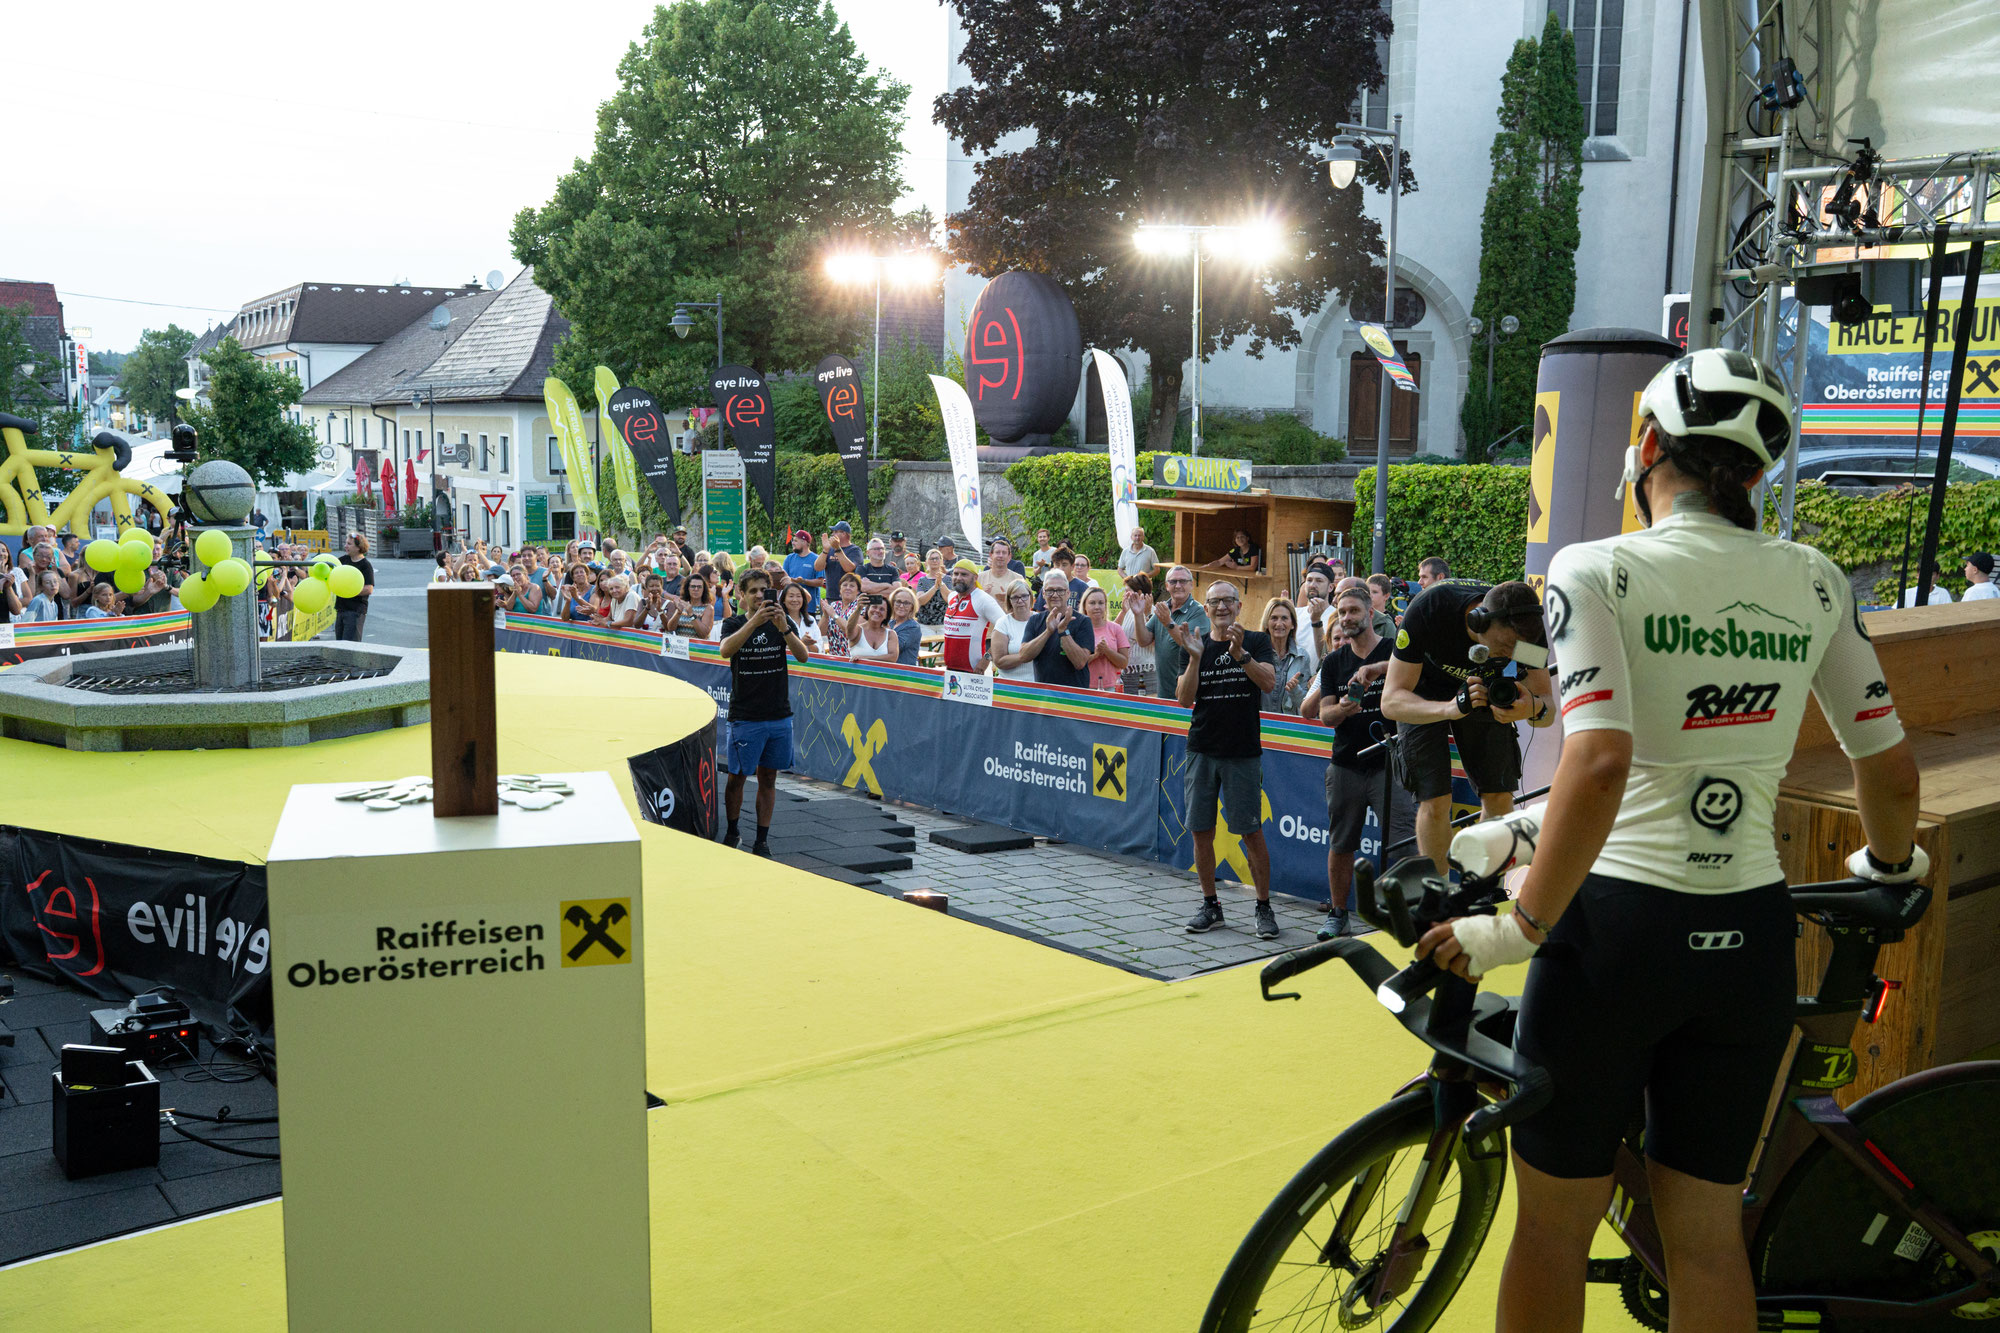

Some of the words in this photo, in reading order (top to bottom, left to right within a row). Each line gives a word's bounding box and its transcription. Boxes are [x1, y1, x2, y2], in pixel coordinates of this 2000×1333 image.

[1186, 458, 1240, 490] DRINKS
[1644, 613, 1812, 663] Wiesbauer
[964, 692, 988, 700] ASSOCIATION
[975, 686, 991, 694] CYCLING
[1685, 682, 1781, 719] RH77
[1692, 716, 1734, 726] FACTORY
[1736, 713, 1770, 722] RACING
[1015, 740, 1087, 771] Raiffeisen
[983, 756, 1087, 794] Oberösterreich
[1686, 852, 1733, 864] RH77
[127, 893, 207, 956] evil
[376, 919, 544, 951] Raiffeisen
[287, 945, 545, 988] Oberösterreich
[1820, 1051, 1853, 1082] 12
